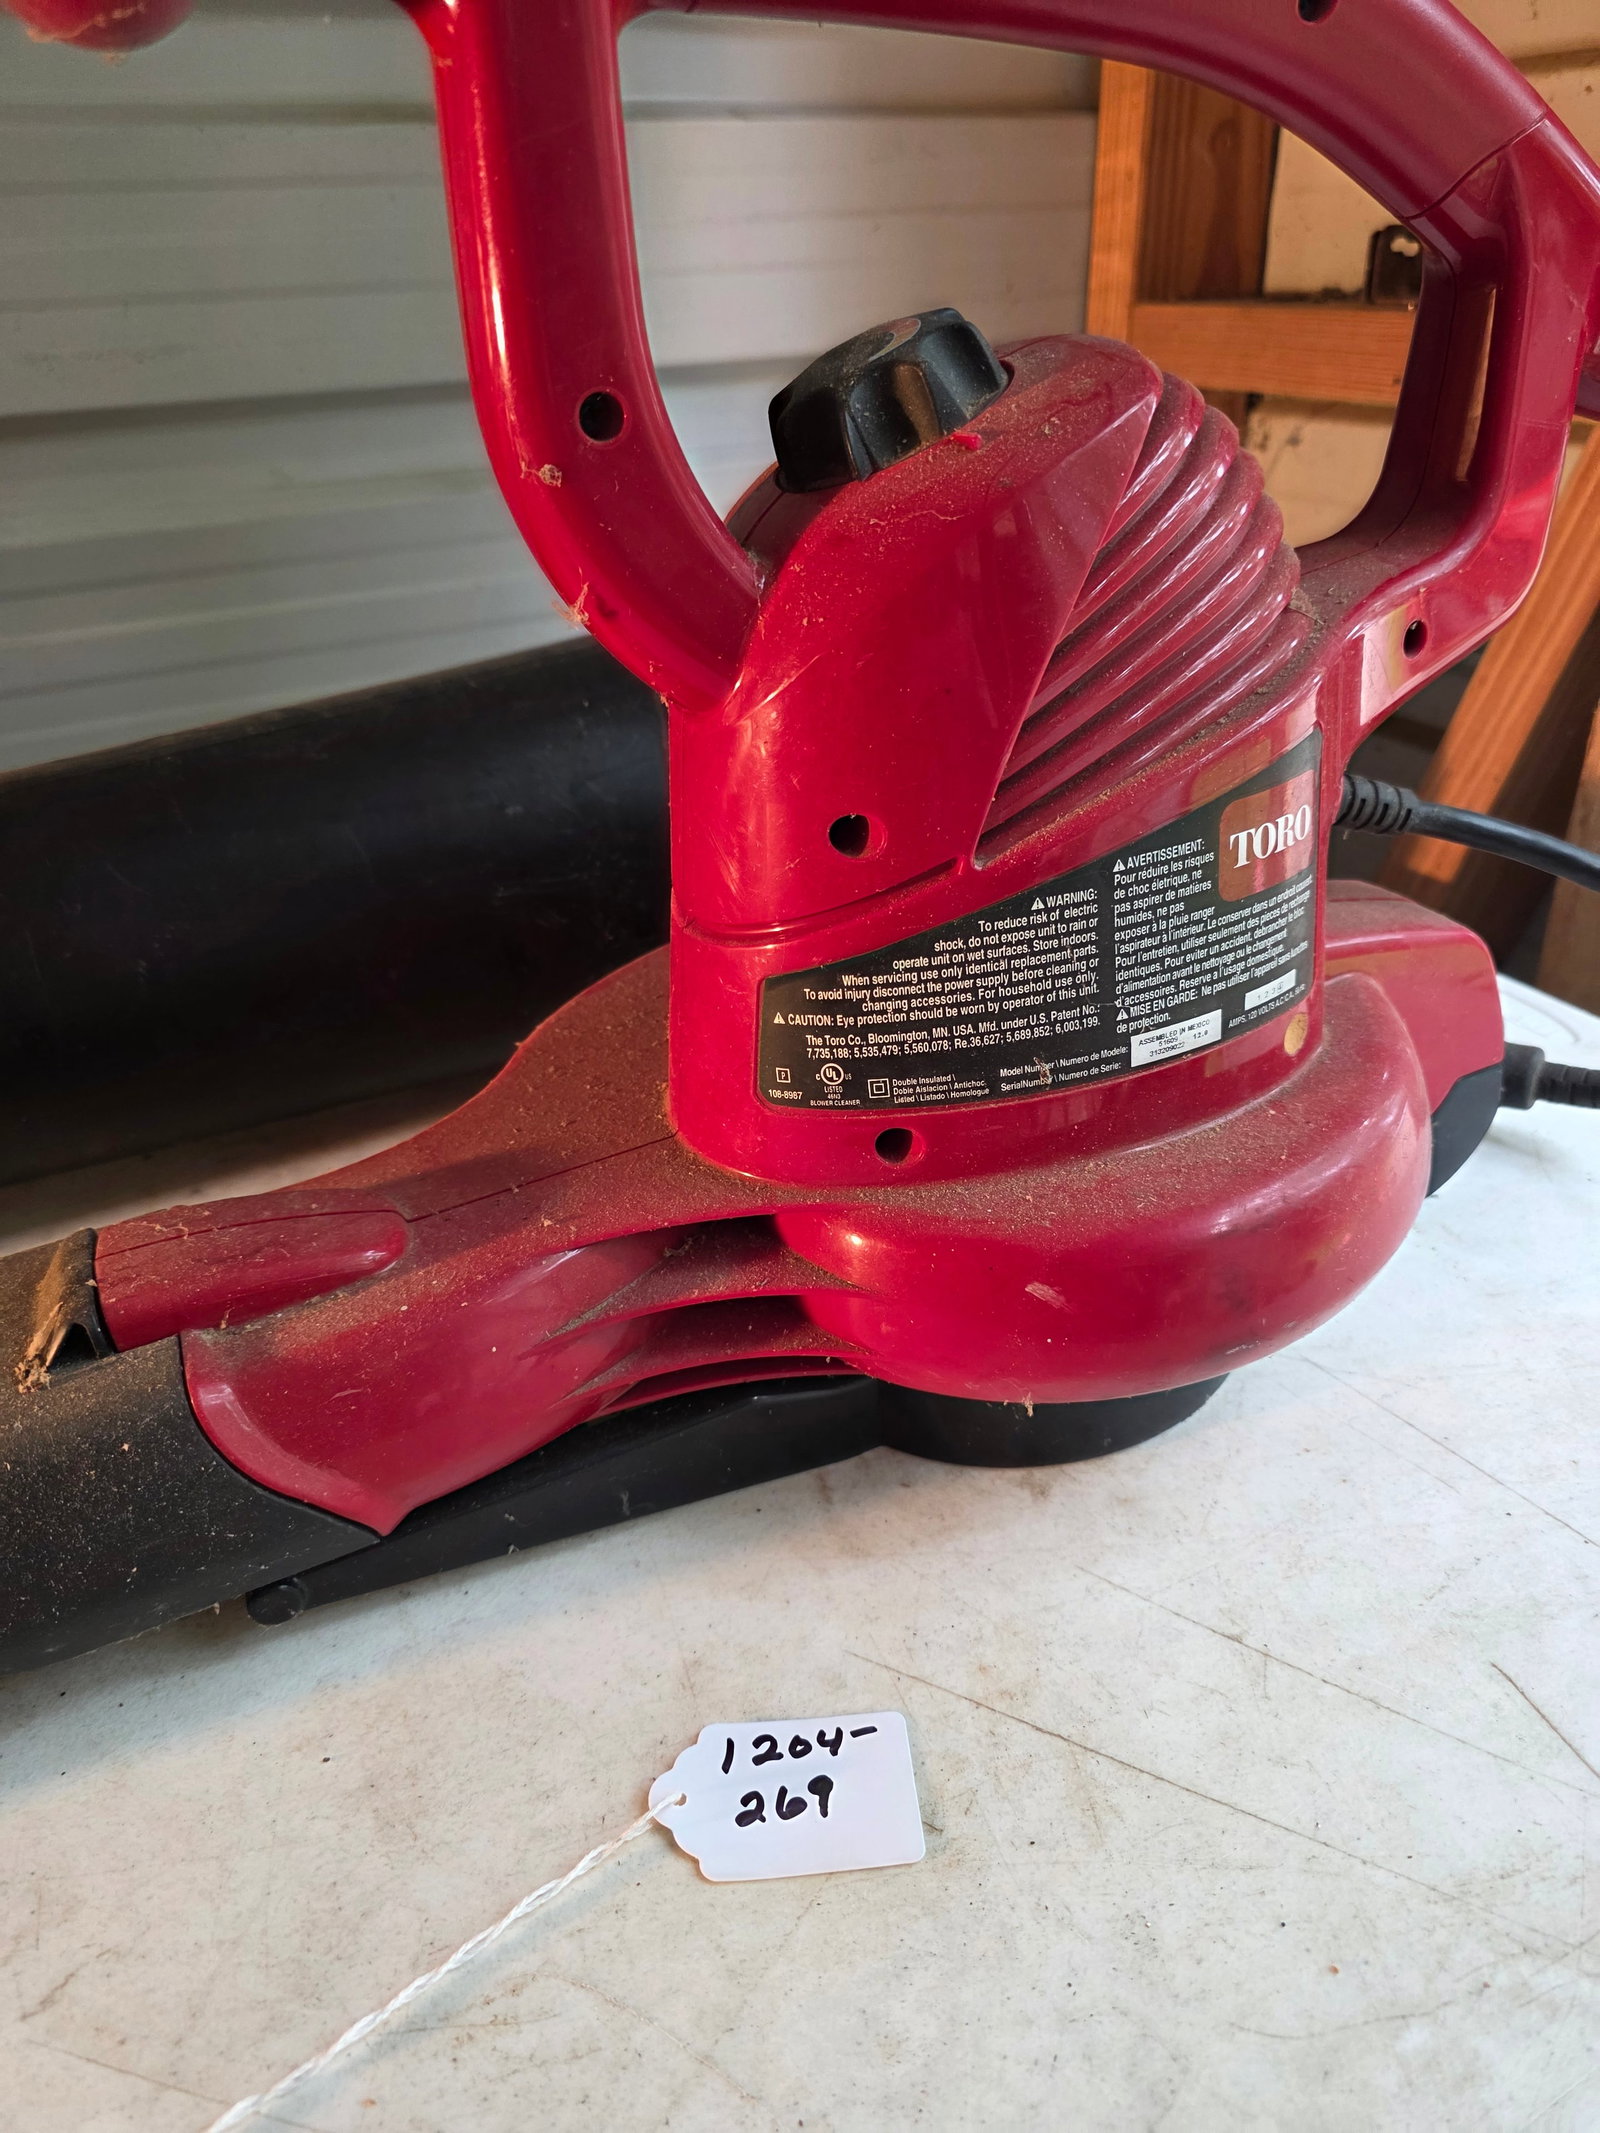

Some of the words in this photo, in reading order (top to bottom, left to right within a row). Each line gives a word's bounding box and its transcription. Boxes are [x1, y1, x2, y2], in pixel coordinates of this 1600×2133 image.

[1230, 804, 1311, 868] TORO
[1114, 873, 1137, 886] Pour
[1138, 865, 1169, 881] réduire
[1171, 861, 1183, 872] les
[1185, 852, 1214, 869] risques
[1127, 839, 1205, 869] AVERTISSEMENT:
[1046, 889, 1098, 908] WARNING:
[1114, 888, 1126, 900] de
[1128, 884, 1150, 897] choc
[1192, 869, 1202, 880] ne
[1114, 902, 1131, 916] pas
[1133, 894, 1164, 910] aspirer
[1165, 891, 1176, 901] de
[1178, 880, 1212, 898] matières
[978, 921, 992, 932] To
[994, 917, 1028, 931] reduce
[1030, 912, 1048, 925] risk
[1050, 908, 1060, 921] of
[1064, 902, 1098, 919] electric
[1115, 925, 1150, 942] exposer
[1159, 920, 1167, 930] la
[1169, 914, 1189, 931] pluie
[1191, 906, 1216, 921] ranger
[1157, 907, 1168, 918] ne
[1170, 902, 1185, 917] pas
[1207, 919, 1217, 930] Le
[1218, 907, 1252, 926] conserver
[1252, 900, 1268, 914] dans
[893, 956, 929, 972] operate
[931, 953, 950, 966] unit
[952, 953, 965, 963] on
[967, 949, 985, 962] wet
[987, 944, 1031, 959] surfaces.
[1033, 939, 1059, 952] Store
[1061, 932, 1099, 947] indoors.
[934, 938, 966, 952] shock,
[968, 936, 981, 948] do
[983, 933, 999, 946] not
[1001, 930, 1036, 944] expose
[1038, 925, 1056, 937] unit
[1057, 924, 1068, 934] to
[1069, 920, 1087, 932] rain
[1089, 918, 1099, 928] or
[1115, 955, 1136, 968] Pour
[1181, 935, 1207, 951] utiliser
[1208, 921, 1246, 943] seulement
[1247, 917, 1260, 929] des
[842, 975, 870, 987] When
[872, 972, 918, 985] servicing
[920, 970, 939, 980] use
[941, 966, 963, 979] only
[966, 958, 1008, 975] identical
[1011, 948, 1073, 970] replacement
[1073, 944, 1099, 961] parts.
[1115, 962, 1163, 982] identiques.
[1165, 956, 1185, 969] Pour
[1209, 944, 1220, 955] un
[1172, 965, 1193, 980] avant
[1194, 963, 1201, 974] le
[1202, 952, 1236, 971] nettoyage
[1236, 948, 1245, 959] ou
[1246, 945, 1252, 955] le
[804, 989, 816, 1000] To
[818, 988, 843, 1000] avoid
[844, 988, 871, 1002] injury
[873, 983, 925, 998] disconnect
[927, 982, 942, 993] the
[944, 979, 974, 994] power
[976, 974, 1009, 988] supply
[1012, 969, 1044, 982] before
[1046, 961, 1087, 976] cleaning
[1089, 958, 1100, 968] or
[862, 998, 908, 1013] changing
[911, 992, 975, 1008] accessories.
[978, 989, 996, 1000] For
[999, 979, 1052, 997] household
[1055, 976, 1073, 988] use
[1075, 970, 1099, 984] only.
[1130, 1002, 1152, 1018] MISE
[1153, 998, 1165, 1012] EN
[1167, 989, 1198, 1008] GARDE:
[1201, 985, 1212, 997] Ne
[1213, 981, 1226, 995] pas
[1227, 972, 1250, 988] utiliser
[1179, 973, 1212, 991] Reserve
[788, 1014, 834, 1026] CAUTION:
[837, 1014, 855, 1028] Eye
[857, 1012, 907, 1028] protection
[910, 1007, 943, 1021] should
[945, 1007, 958, 1017] be
[960, 1004, 985, 1015] worn
[987, 1002, 1000, 1014] by
[1003, 995, 1044, 1012] operator
[1047, 990, 1056, 1003] of
[1059, 989, 1077, 1001] this
[1079, 983, 1100, 996] unit.
[805, 1035, 823, 1046] The
[824, 1035, 846, 1046] Toro
[868, 1030, 930, 1044] Bloomington,
[932, 1027, 951, 1038] MN.
[953, 1024, 976, 1036] USA.
[979, 1021, 999, 1033] Mfd.
[1001, 1018, 1028, 1030] under
[1030, 1014, 1049, 1026] U.S.
[1051, 1007, 1080, 1022] Patent
[1117, 1023, 1128, 1034] de
[1129, 1012, 1171, 1033] protection.
[1138, 1030, 1177, 1046] ASSEMBLED
[1188, 1019, 1210, 1032] MEXICO
[892, 1078, 917, 1087] Double
[919, 1074, 952, 1084] Insulated
[1000, 1066, 1023, 1077] Model
[1060, 1055, 1090, 1067] Numero
[1090, 1052, 1100, 1061] de
[1059, 1070, 1089, 1082] Numero
[1090, 1067, 1100, 1075] de
[768, 1089, 802, 1100] 108-8987
[893, 1087, 914, 1095] Doble
[920, 1093, 946, 1102] Listado
[735, 1774, 834, 1828] 269
